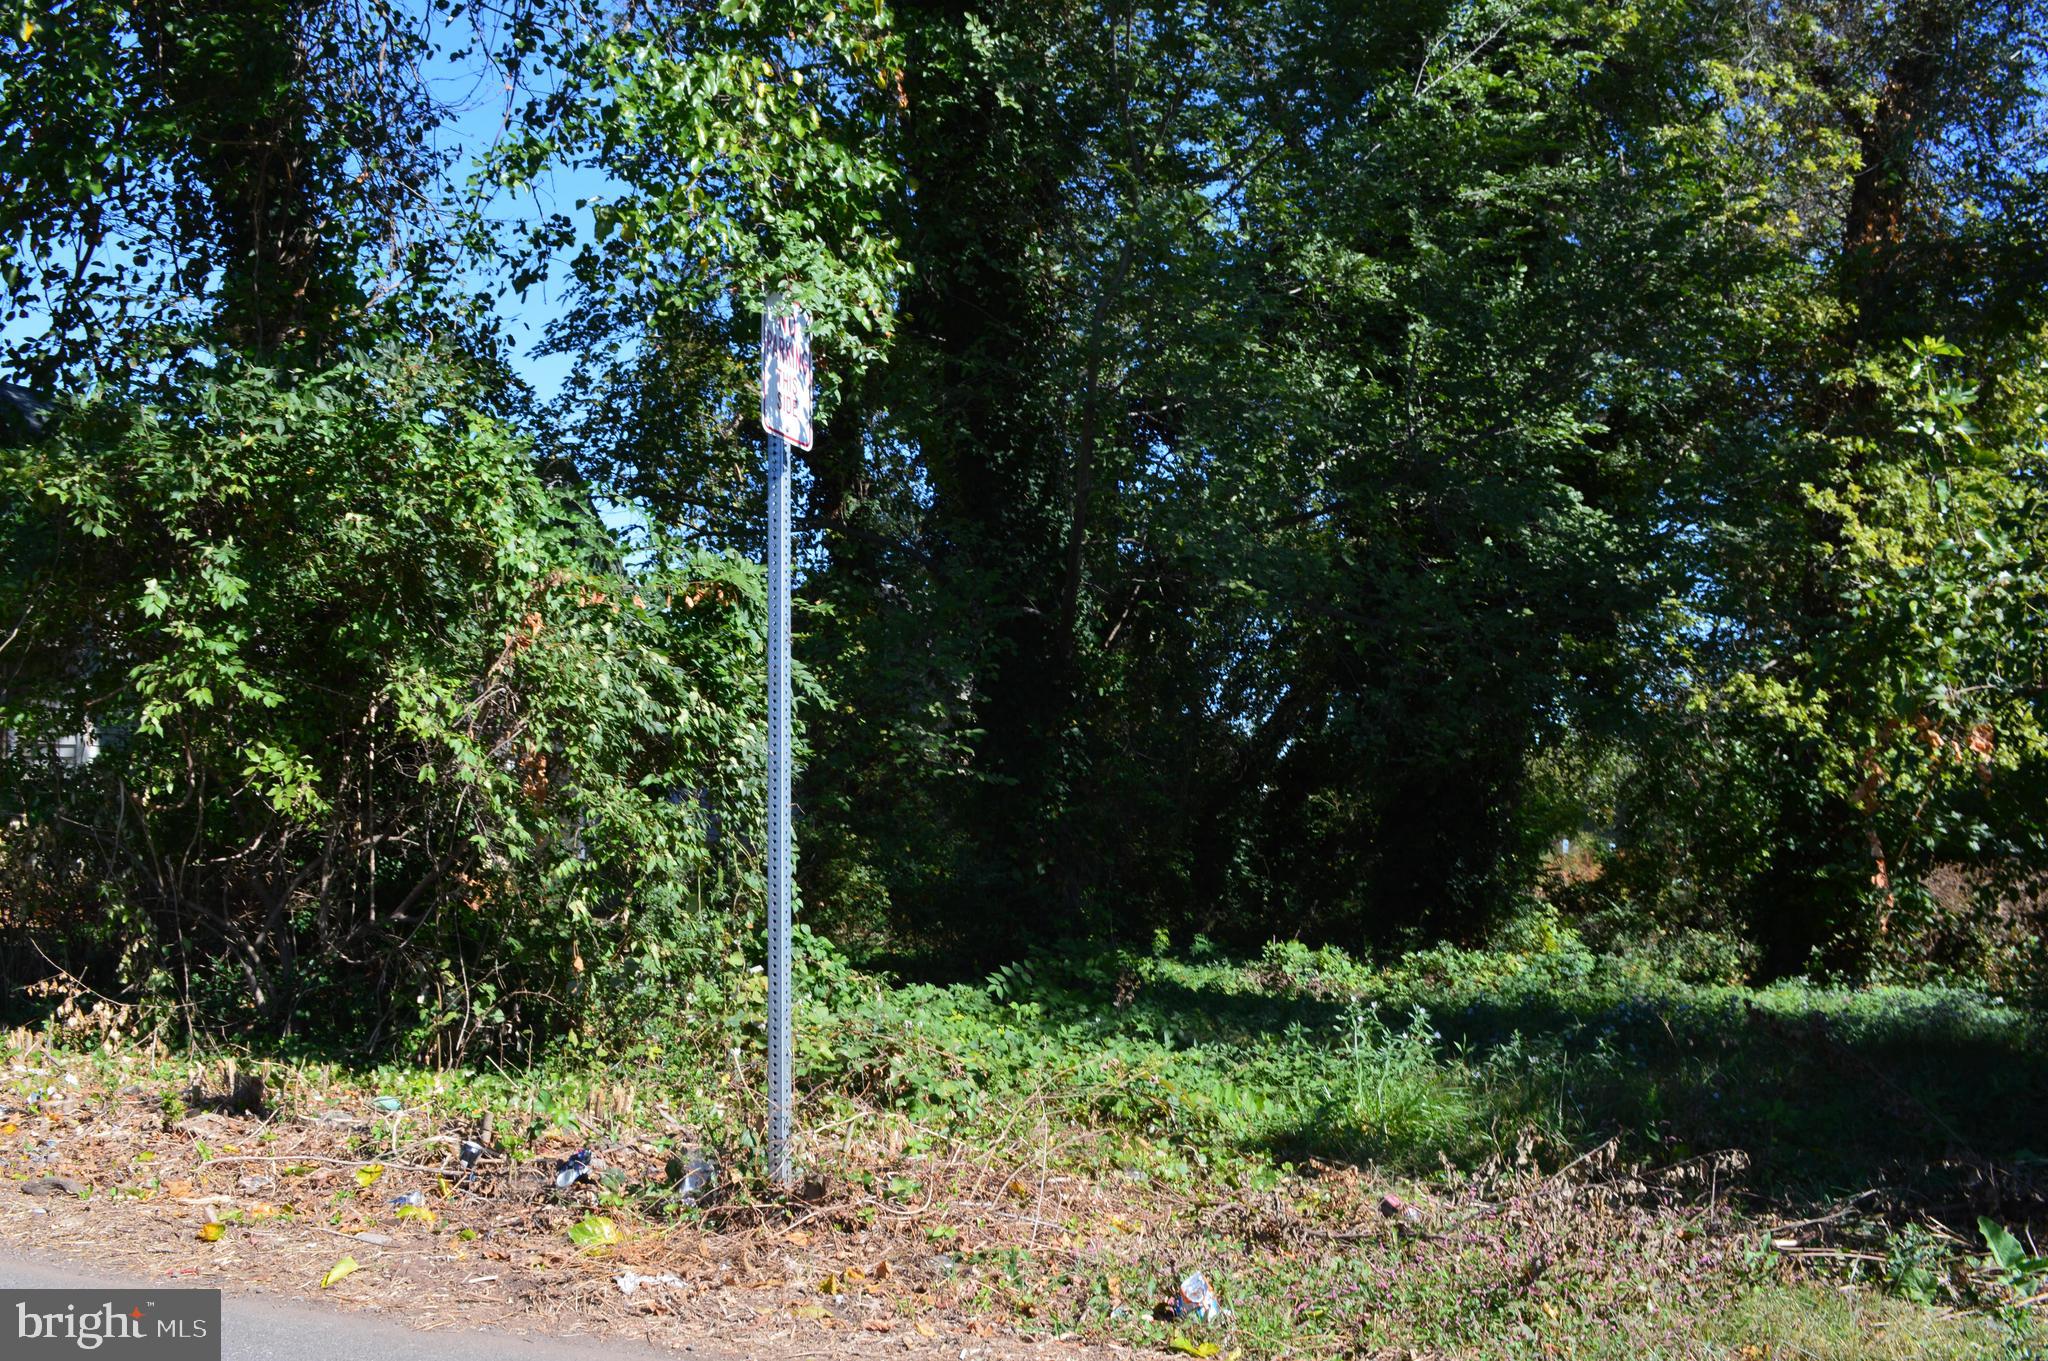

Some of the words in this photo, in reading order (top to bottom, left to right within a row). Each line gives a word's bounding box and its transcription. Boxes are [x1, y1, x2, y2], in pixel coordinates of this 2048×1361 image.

[767, 329, 809, 375] PARKING
[776, 367, 798, 395] THIS
[777, 391, 798, 418] SIDE
